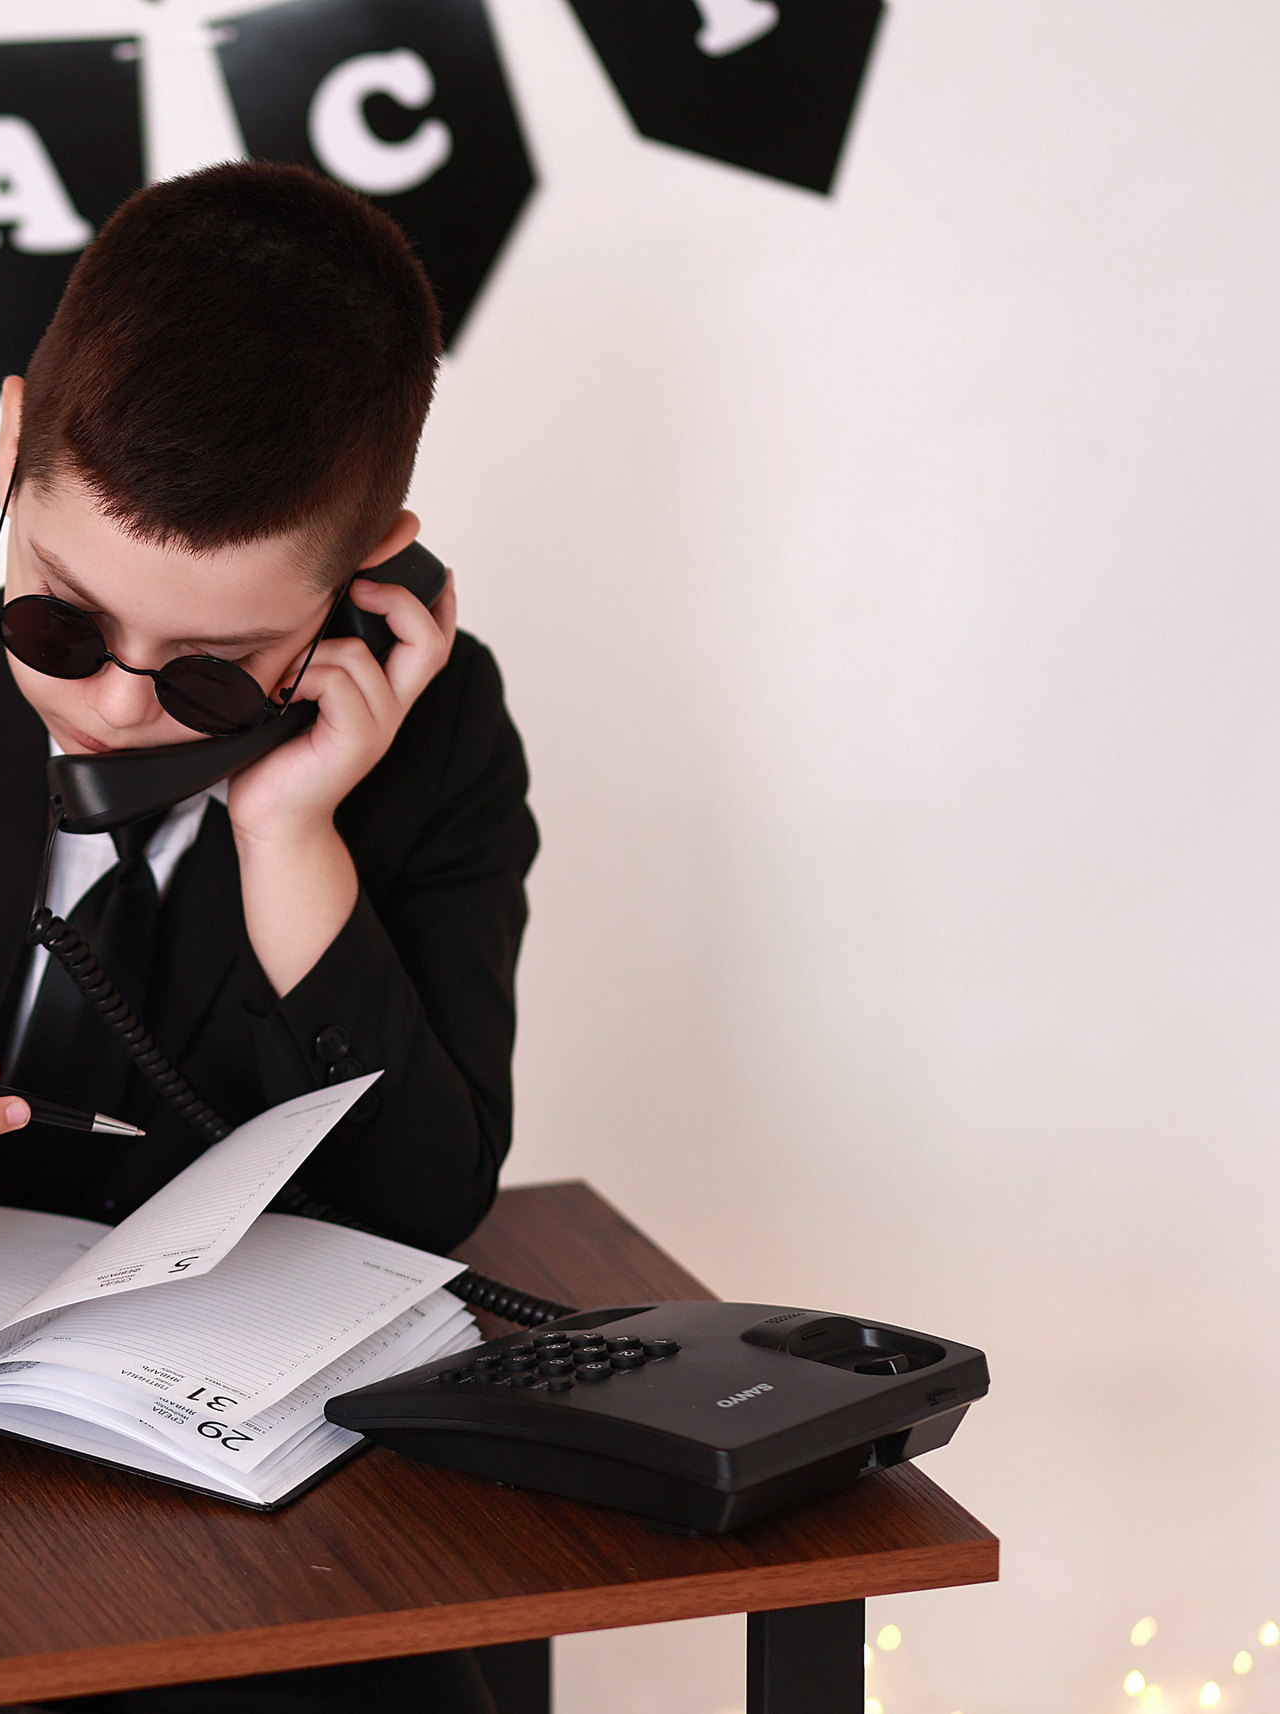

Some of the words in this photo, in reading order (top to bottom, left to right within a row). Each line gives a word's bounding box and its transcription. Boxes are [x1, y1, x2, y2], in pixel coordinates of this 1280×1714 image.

[168, 1256, 199, 1274] 5
[120, 1369, 170, 1391] ПЯТНИЦА
[142, 1365, 182, 1383] ЯНВАРЬ
[186, 1387, 239, 1413] 31
[716, 1383, 774, 1408] SANYO
[152, 1405, 185, 1425] СРЕДА
[197, 1420, 255, 1452] 29
